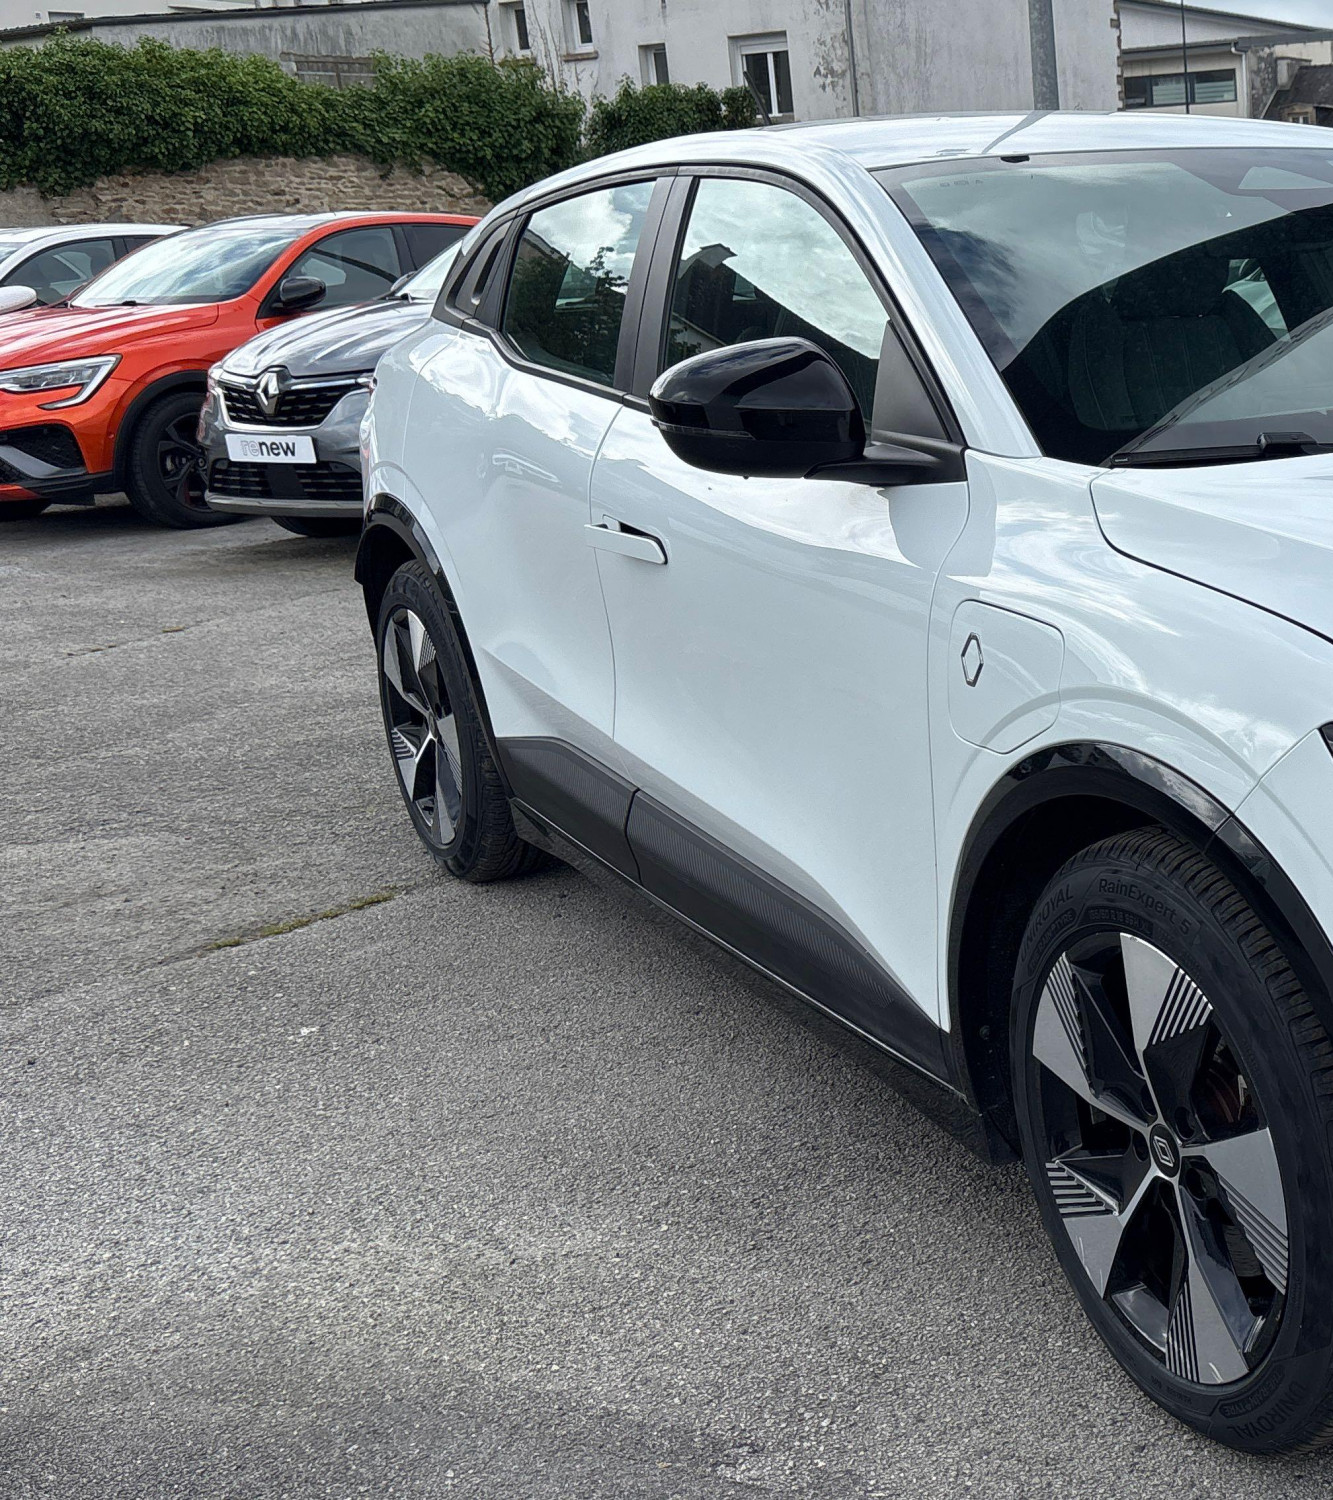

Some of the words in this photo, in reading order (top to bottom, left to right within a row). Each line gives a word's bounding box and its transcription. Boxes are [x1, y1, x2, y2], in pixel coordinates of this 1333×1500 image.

[240, 440, 296, 457] renew
[1020, 883, 1074, 962] UNIROYAL
[1098, 878, 1178, 926] RainExpert
[1179, 918, 1192, 935] 5
